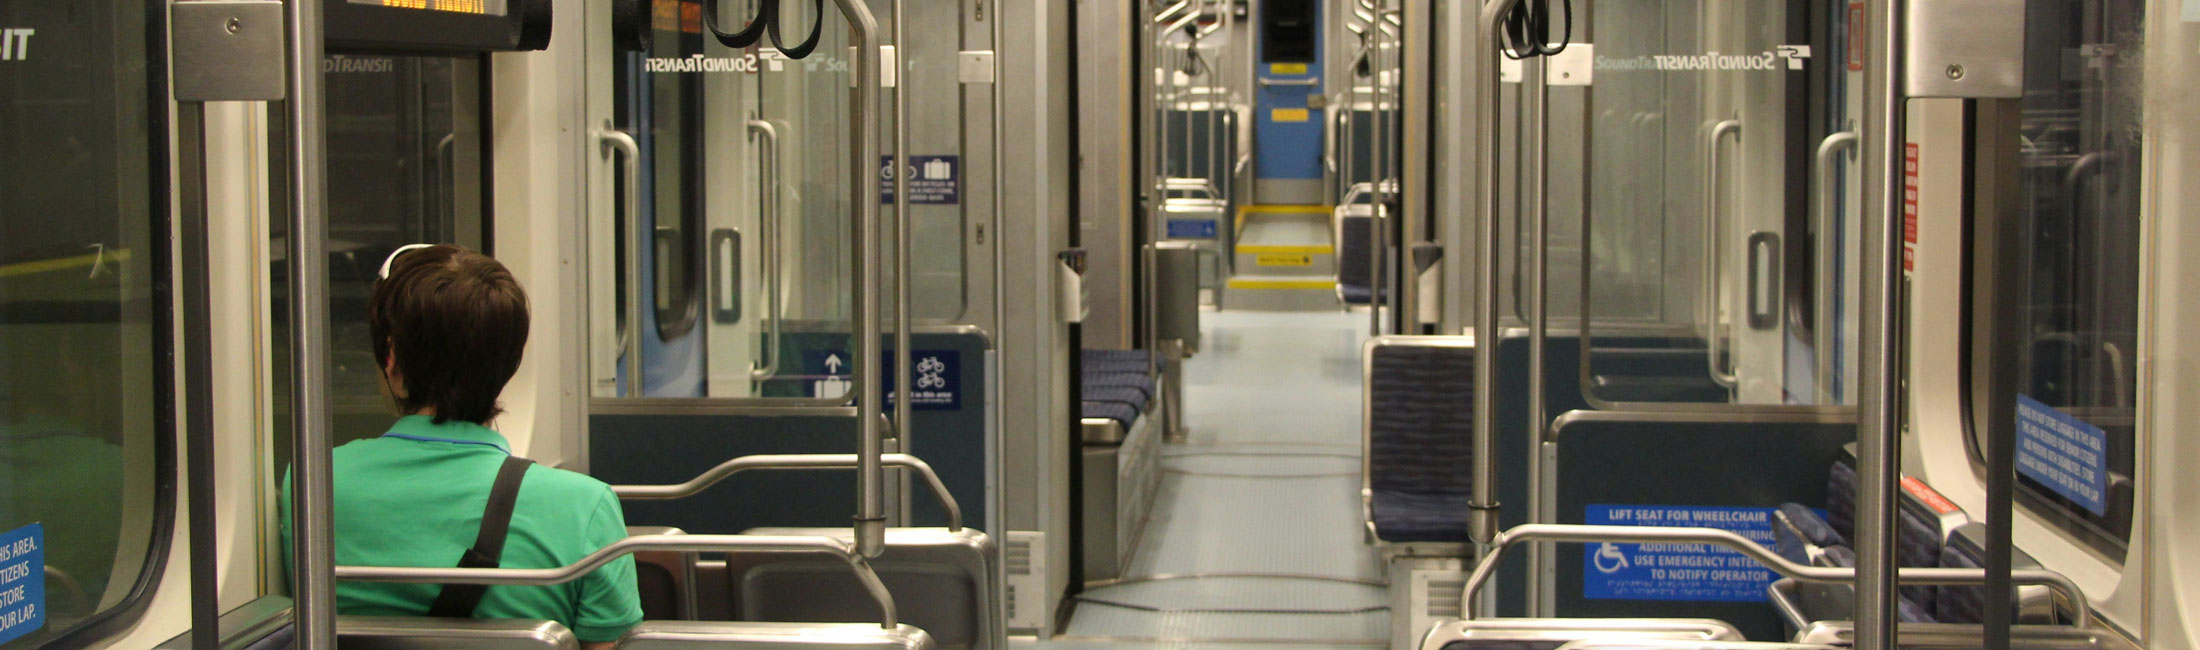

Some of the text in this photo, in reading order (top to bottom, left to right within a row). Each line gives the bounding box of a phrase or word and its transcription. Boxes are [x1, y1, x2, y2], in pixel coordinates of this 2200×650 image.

[0, 28, 35, 60] IT
[1608, 509, 1767, 522] LIFT SEAT FOR WHEELCHAIR
[12, 536, 37, 558] AREA.
[1638, 543, 1707, 553] ADDITIONAL
[1634, 555, 1766, 567] USE EMERGENCY INTER
[1651, 568, 1768, 580] TO NOTIFY OPERATOR
[18, 603, 36, 624] LAP.
